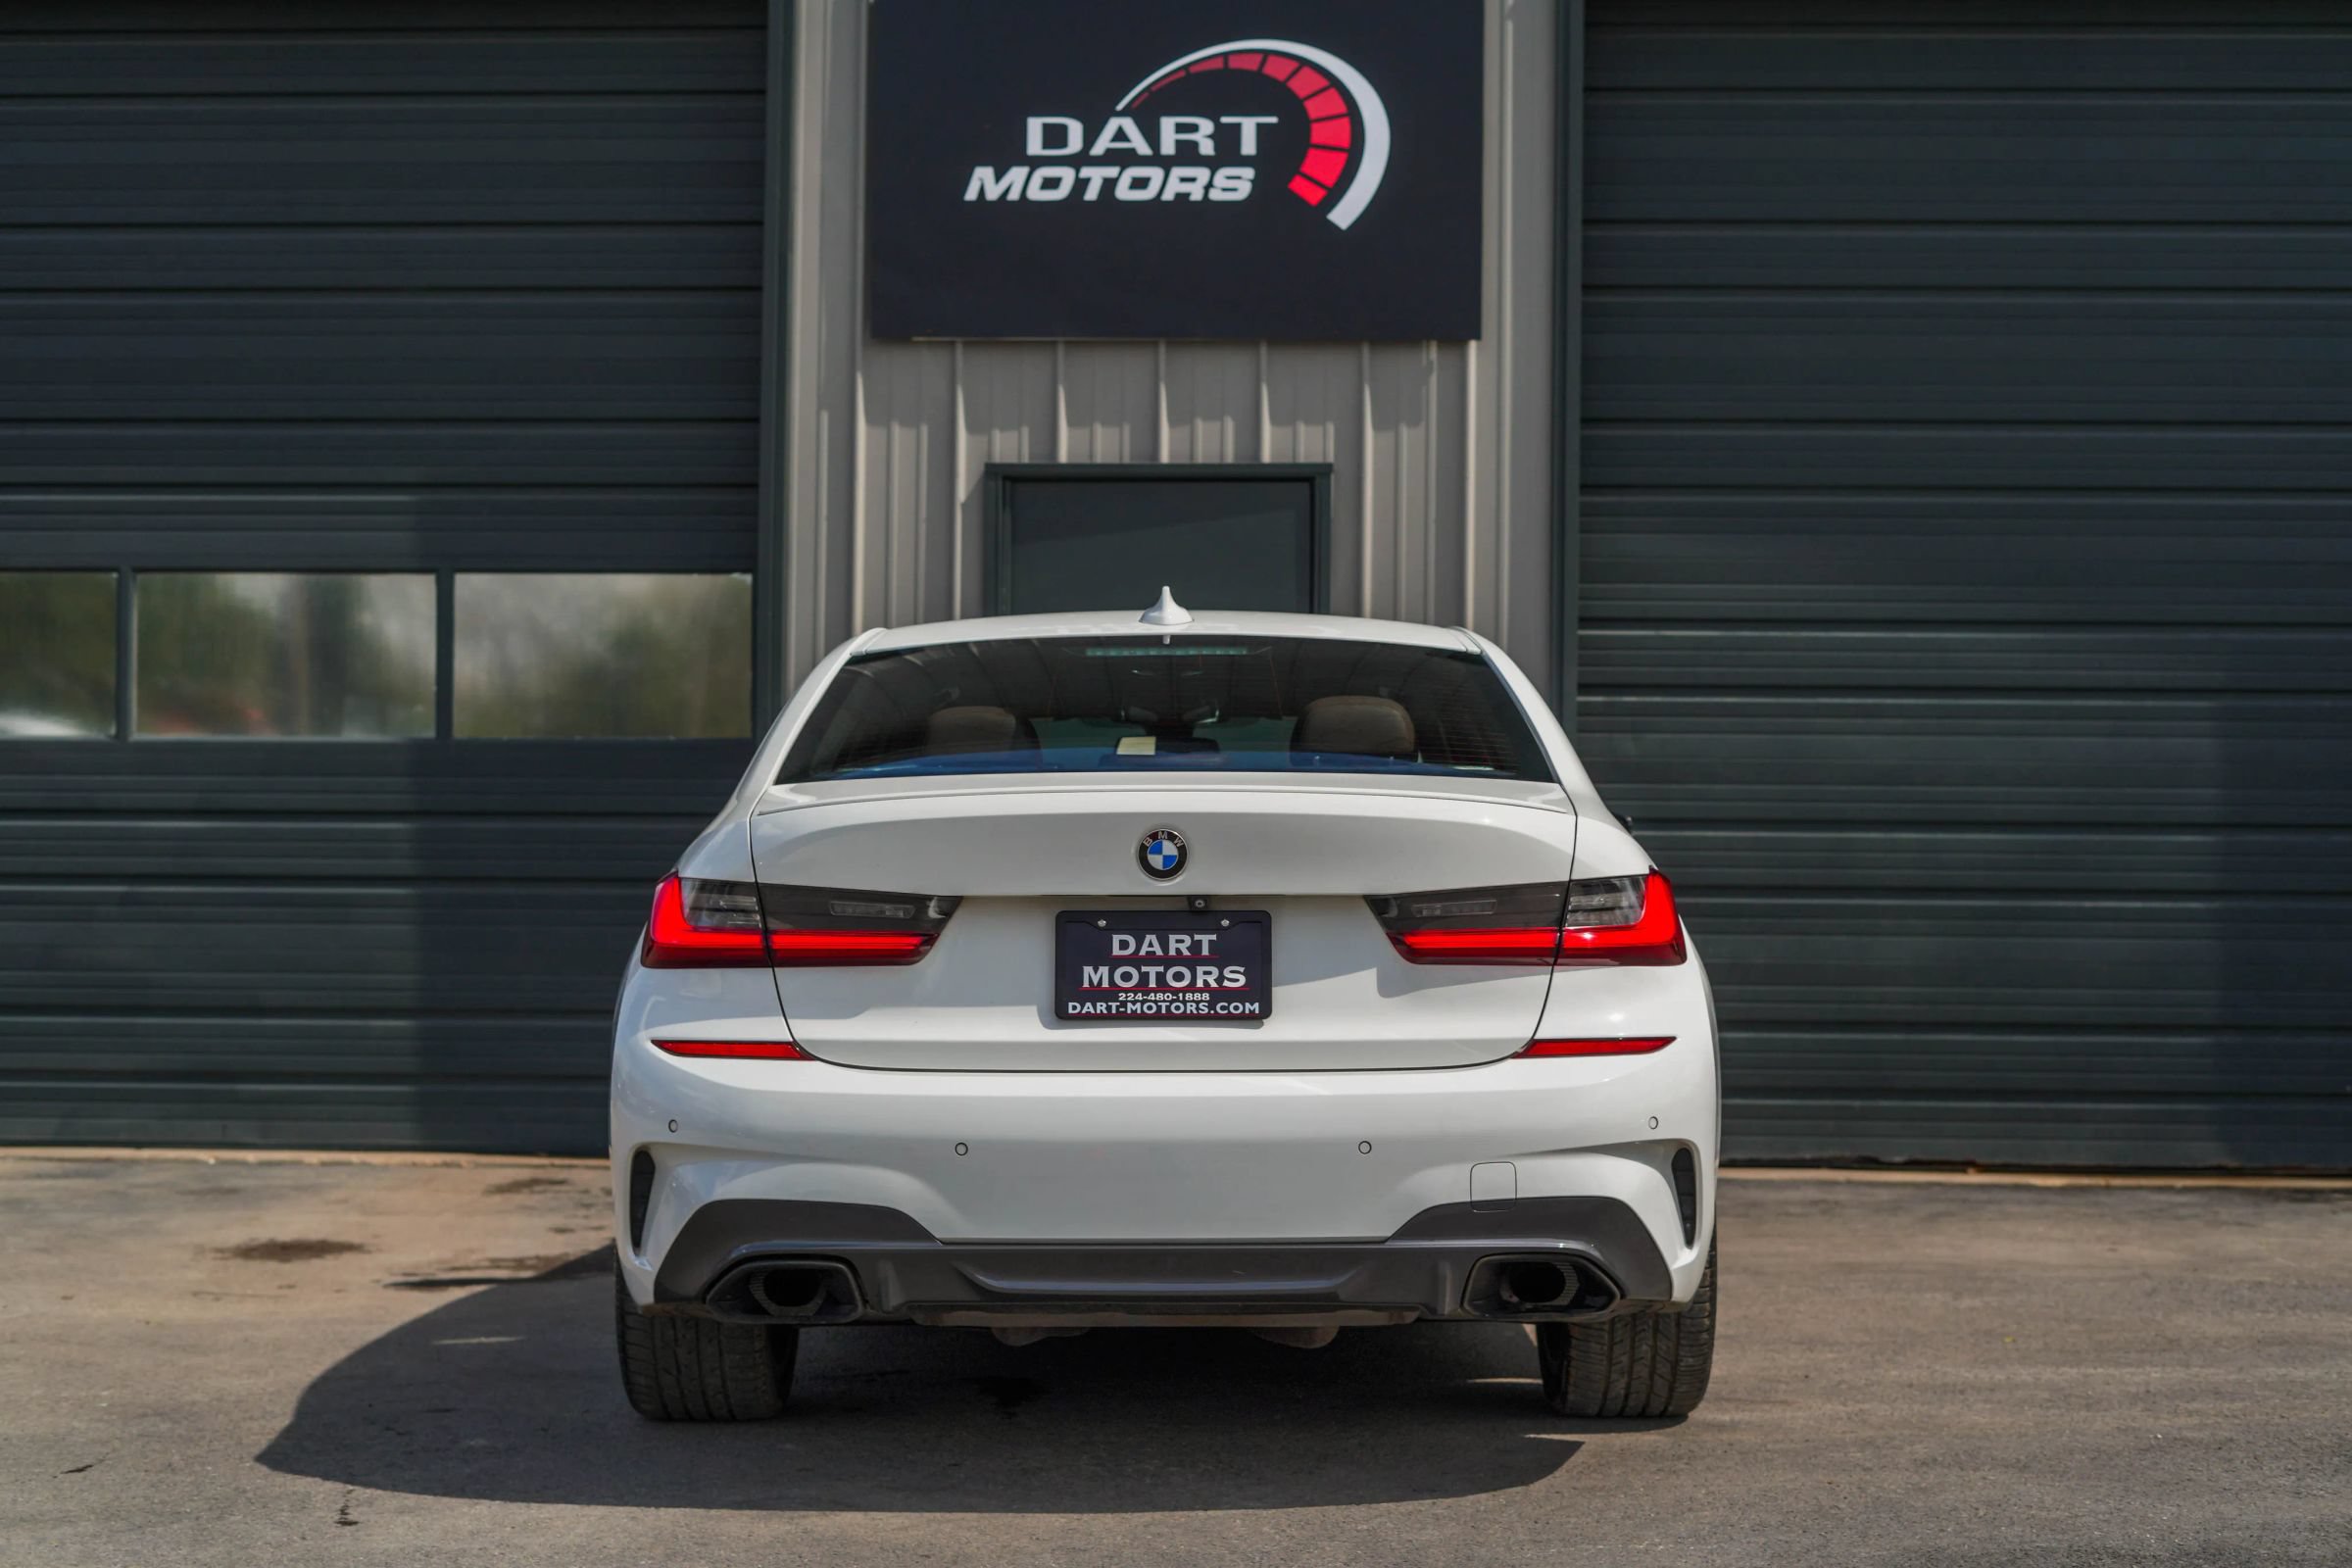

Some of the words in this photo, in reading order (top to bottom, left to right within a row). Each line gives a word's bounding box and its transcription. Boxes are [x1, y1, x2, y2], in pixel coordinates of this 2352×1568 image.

[1026, 116, 1278, 156] DART
[963, 166, 1255, 202] MOTORS
[1143, 831, 1185, 848] BMW
[1111, 934, 1217, 956] DART
[1082, 965, 1247, 988] MOTORS
[1067, 1002, 1260, 1014] DART-MOTORS.COM
[1118, 992, 1210, 1002] 224-480-1888
